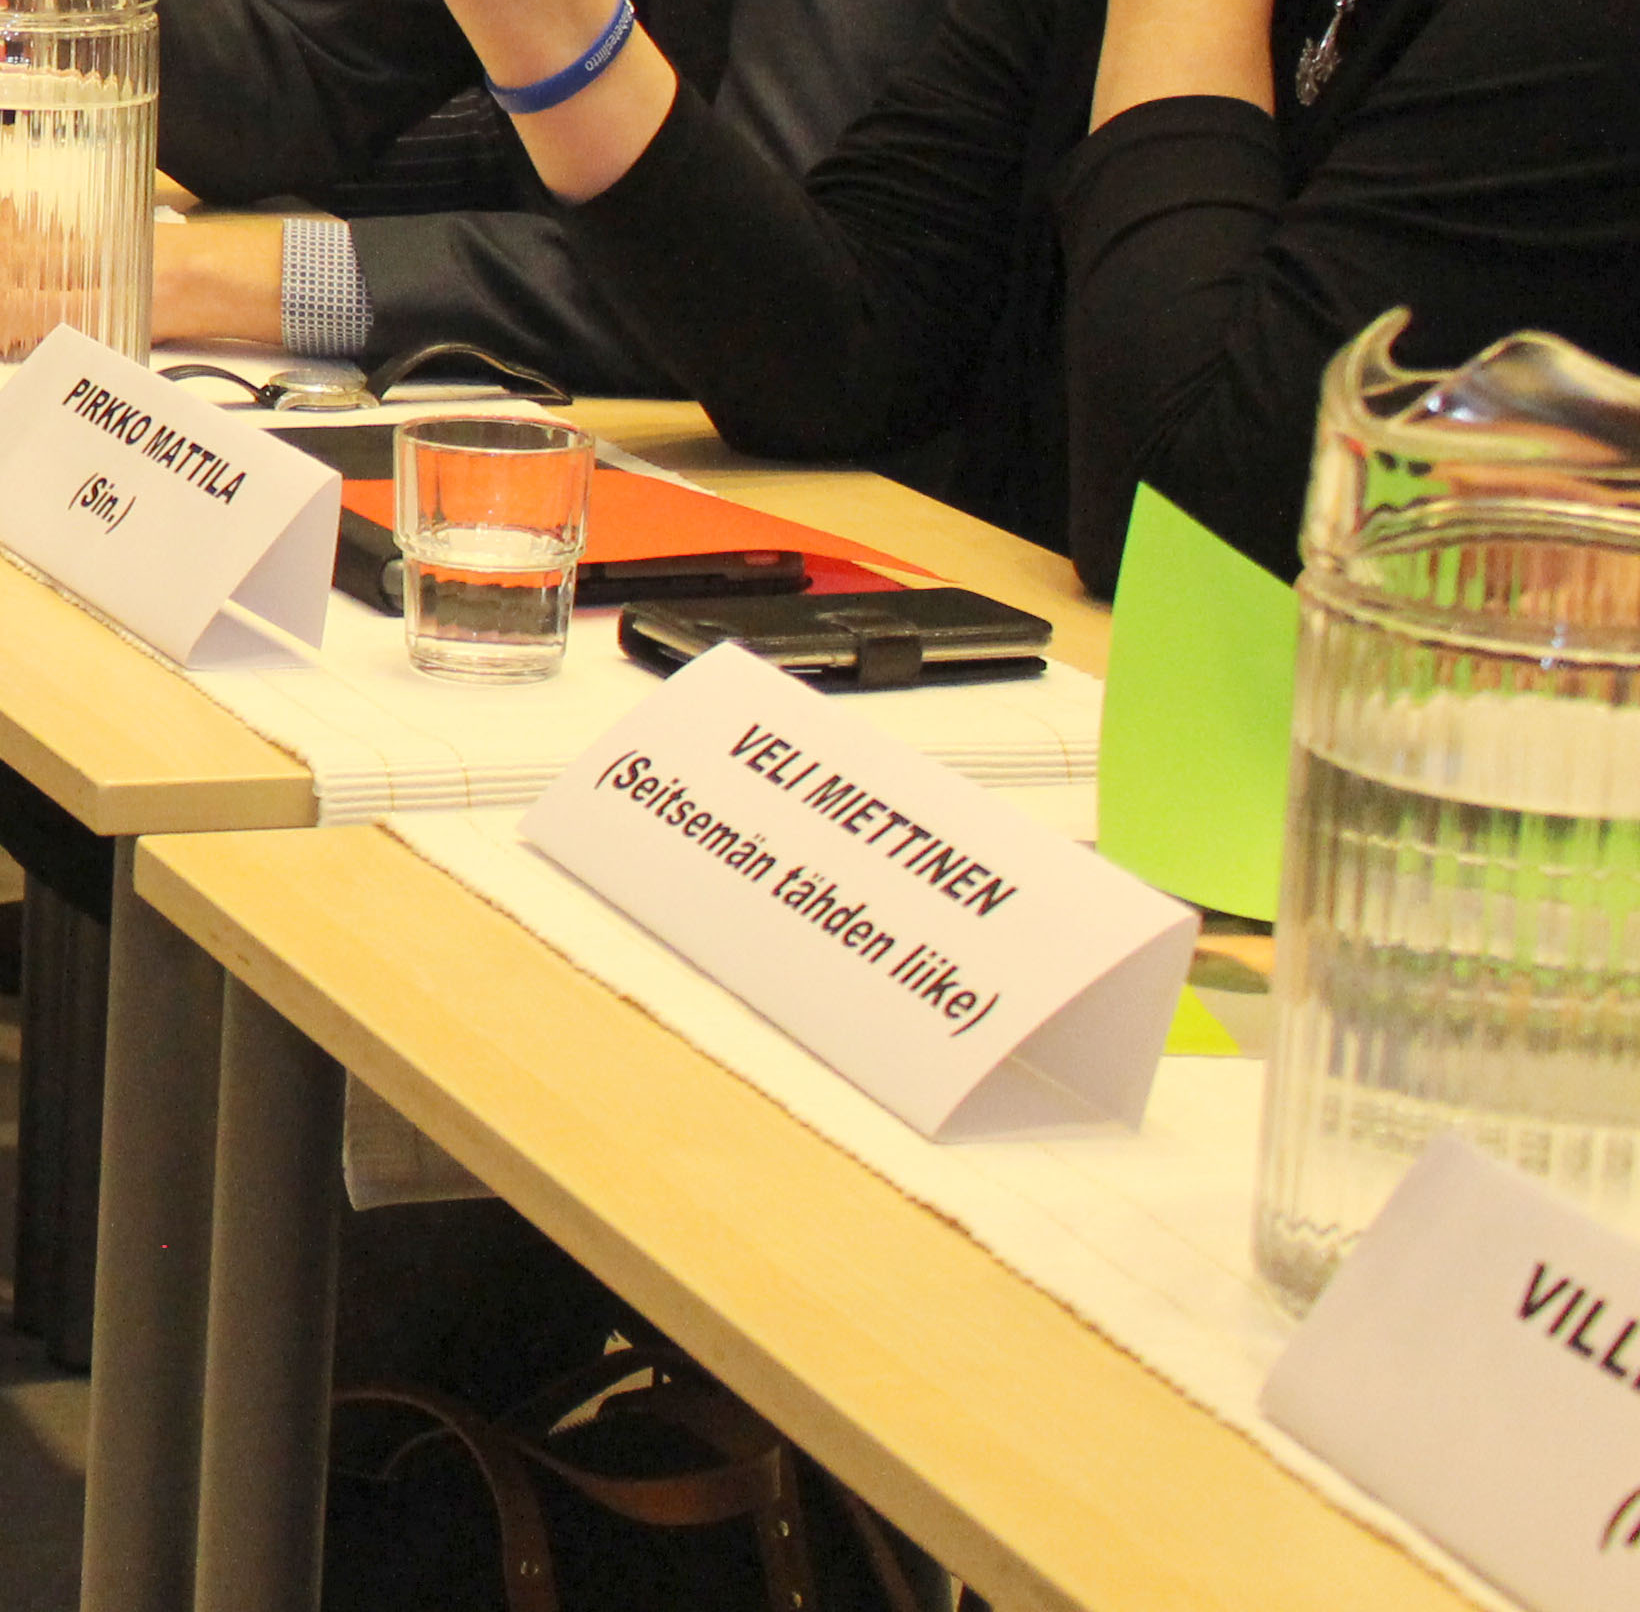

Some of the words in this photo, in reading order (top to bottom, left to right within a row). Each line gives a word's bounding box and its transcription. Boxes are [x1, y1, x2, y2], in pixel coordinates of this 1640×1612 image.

[62, 377, 152, 445] PIRKKO
[141, 424, 247, 505] MATTILA
[68, 472, 136, 535] (Sin.)
[729, 723, 821, 791] VELI
[802, 773, 1018, 918] MIETTINEN
[594, 749, 777, 883] (Seitsemän
[771, 865, 897, 964] tähden
[888, 944, 1000, 1038] liike)
[1518, 1261, 1640, 1393] VILL
